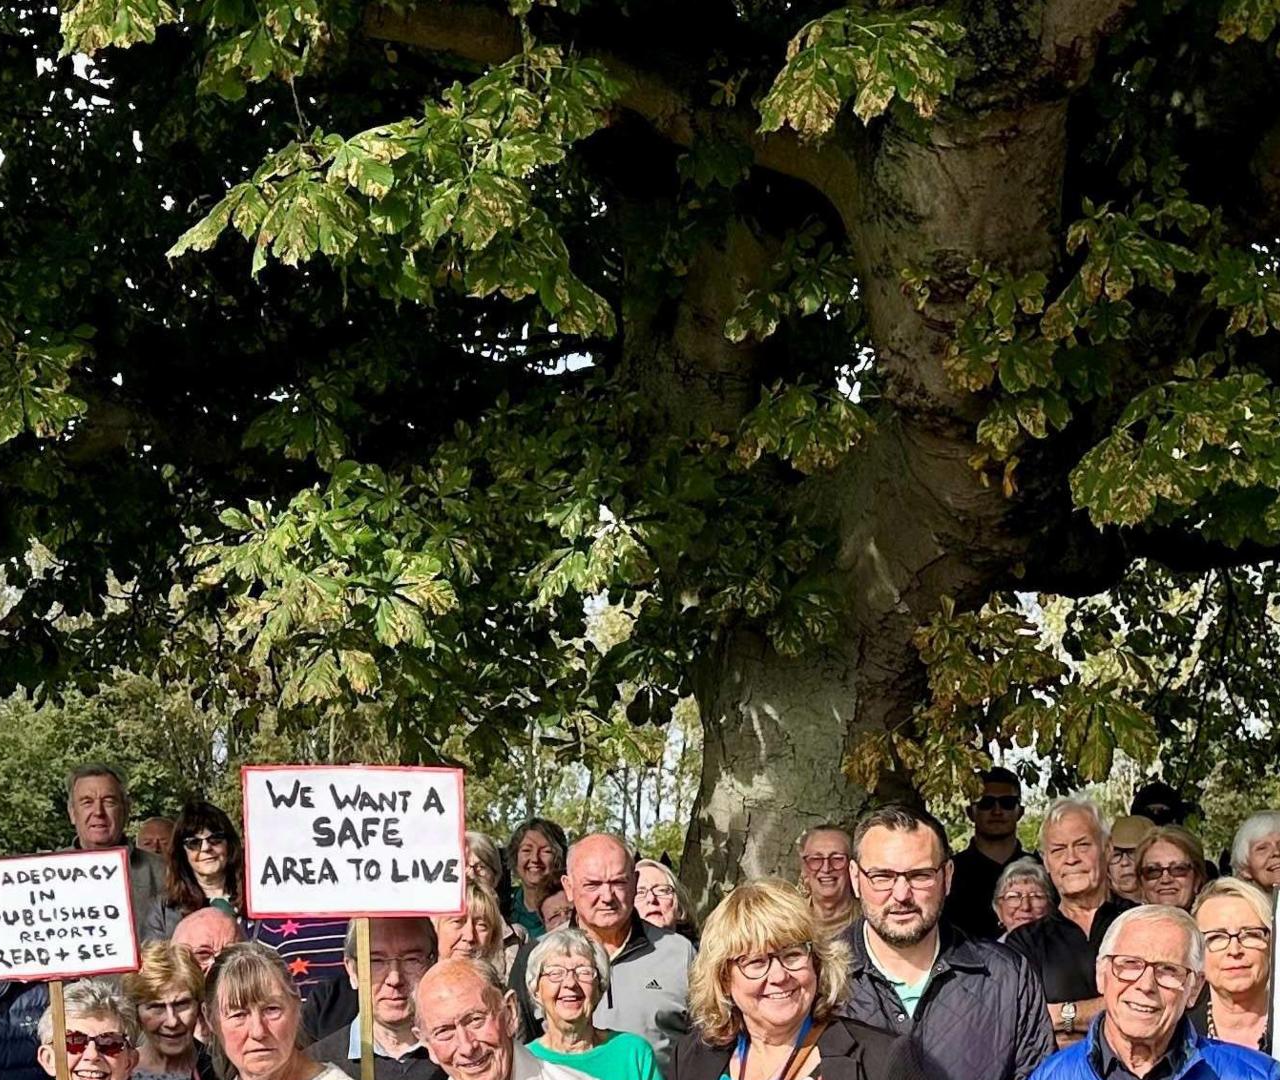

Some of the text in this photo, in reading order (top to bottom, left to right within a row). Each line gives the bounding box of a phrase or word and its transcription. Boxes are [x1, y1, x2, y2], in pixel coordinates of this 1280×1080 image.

[265, 779, 445, 815] WE WANT A
[312, 816, 404, 850] SAFE
[260, 856, 459, 886] AREA TO LIVE
[30, 889, 55, 906] IN
[20, 925, 108, 943] REPORTS
[55, 947, 69, 961] +
[77, 943, 118, 961] SEE
